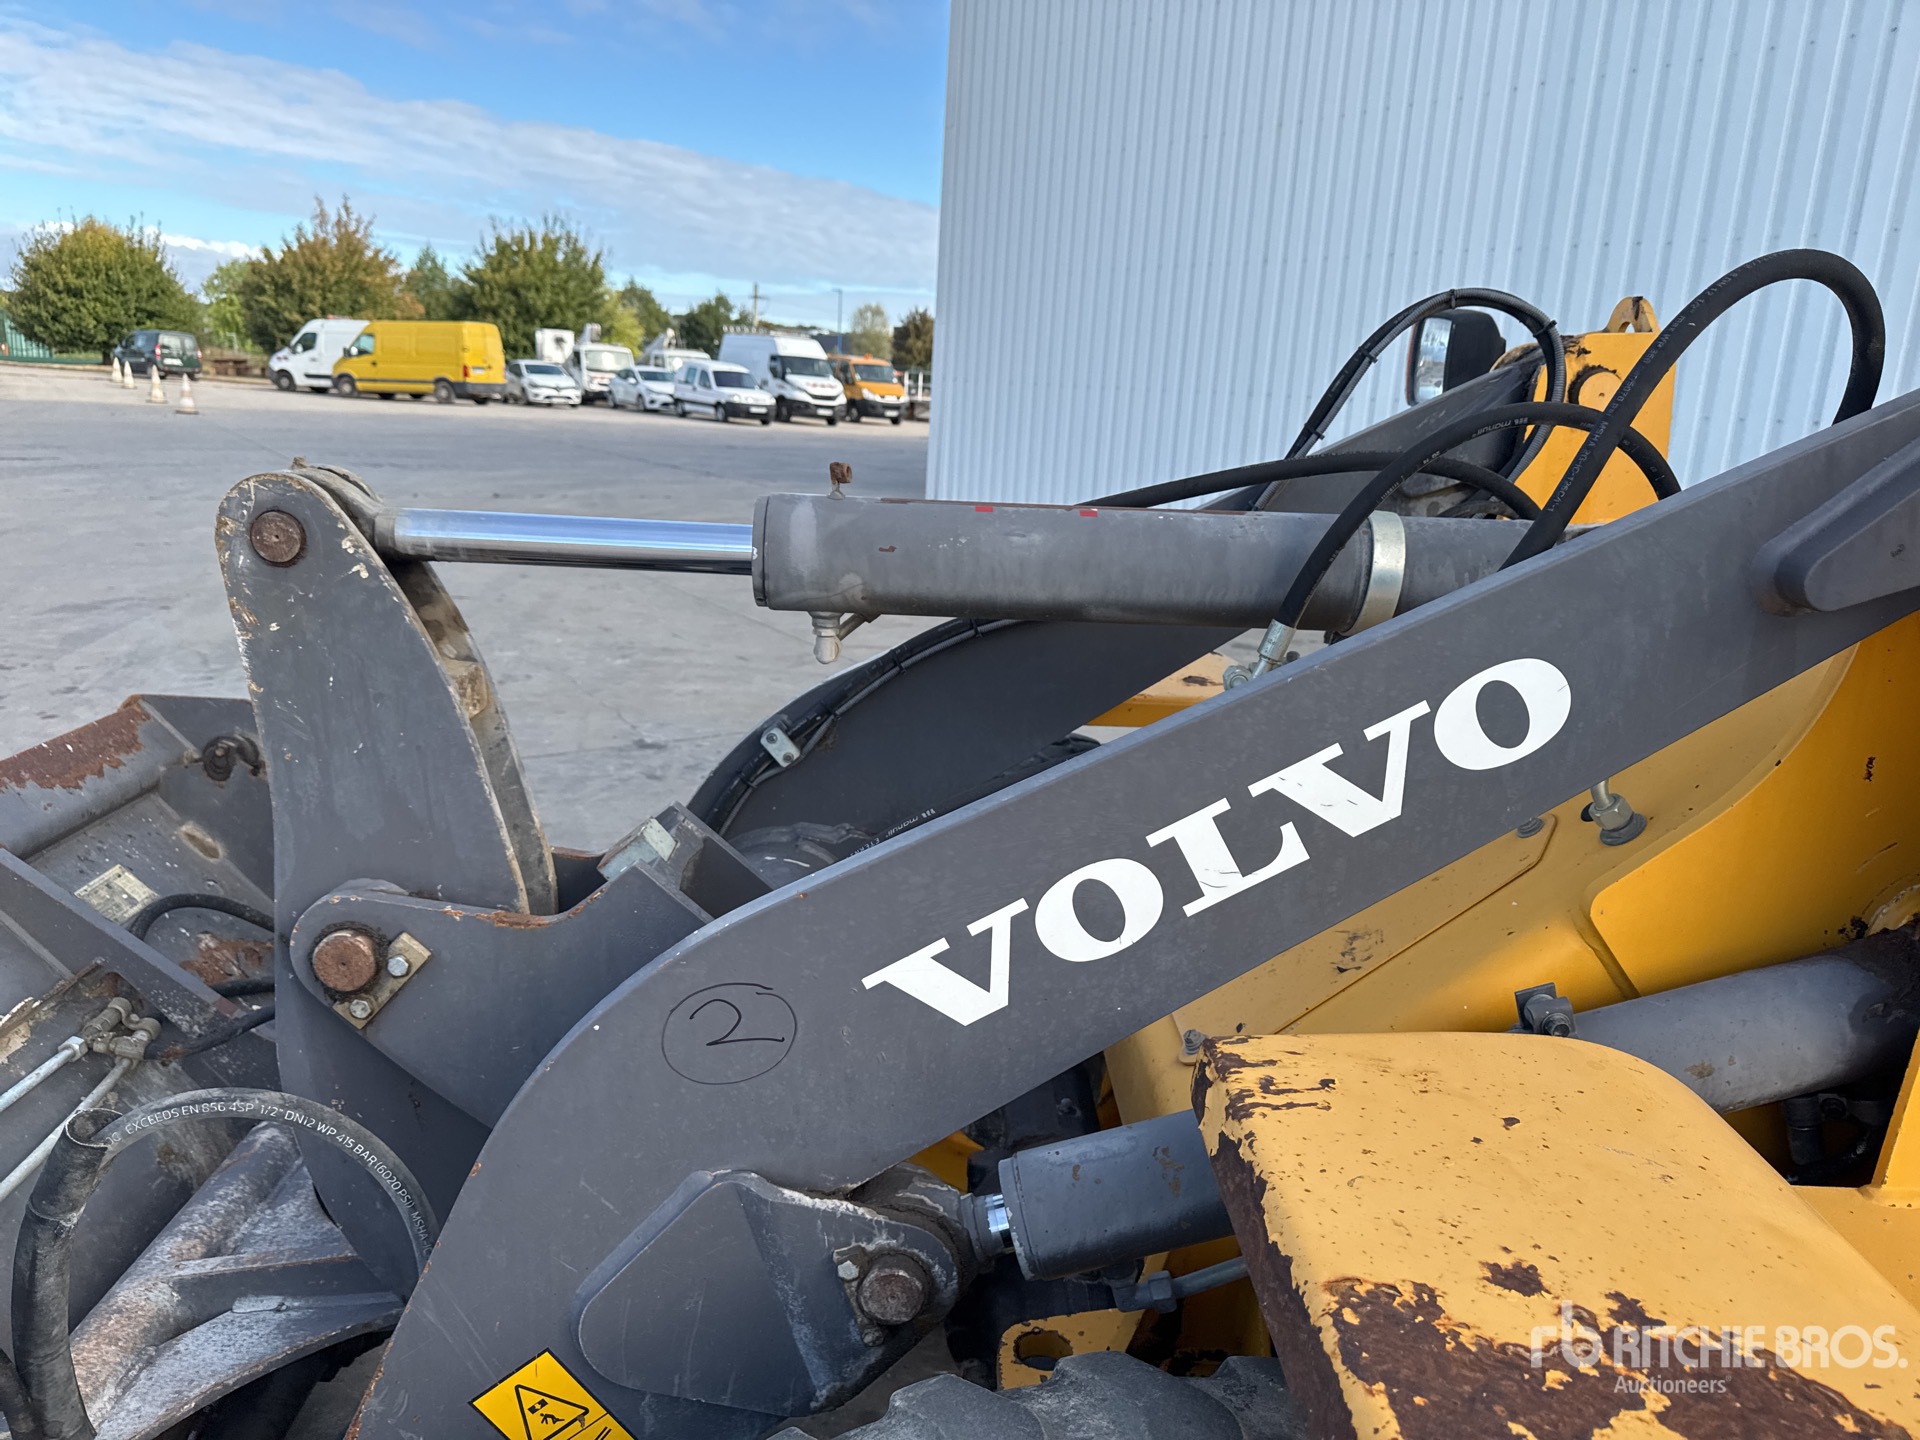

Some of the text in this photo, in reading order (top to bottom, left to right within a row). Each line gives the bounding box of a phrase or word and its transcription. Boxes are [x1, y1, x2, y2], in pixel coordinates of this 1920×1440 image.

[1588, 420, 1609, 447] MSHA
[861, 658, 1571, 1026] VOLVO
[689, 998, 785, 1046] 2
[125, 1107, 180, 1135] EXCEEDS
[181, 1104, 199, 1116] EN
[201, 1101, 226, 1113] 856
[228, 1101, 255, 1112] 4SP
[316, 1121, 337, 1136] WP
[336, 1135, 356, 1149] 415
[353, 1143, 378, 1168] BAR
[375, 1161, 402, 1191] (6020
[397, 1188, 416, 1208] PSI)
